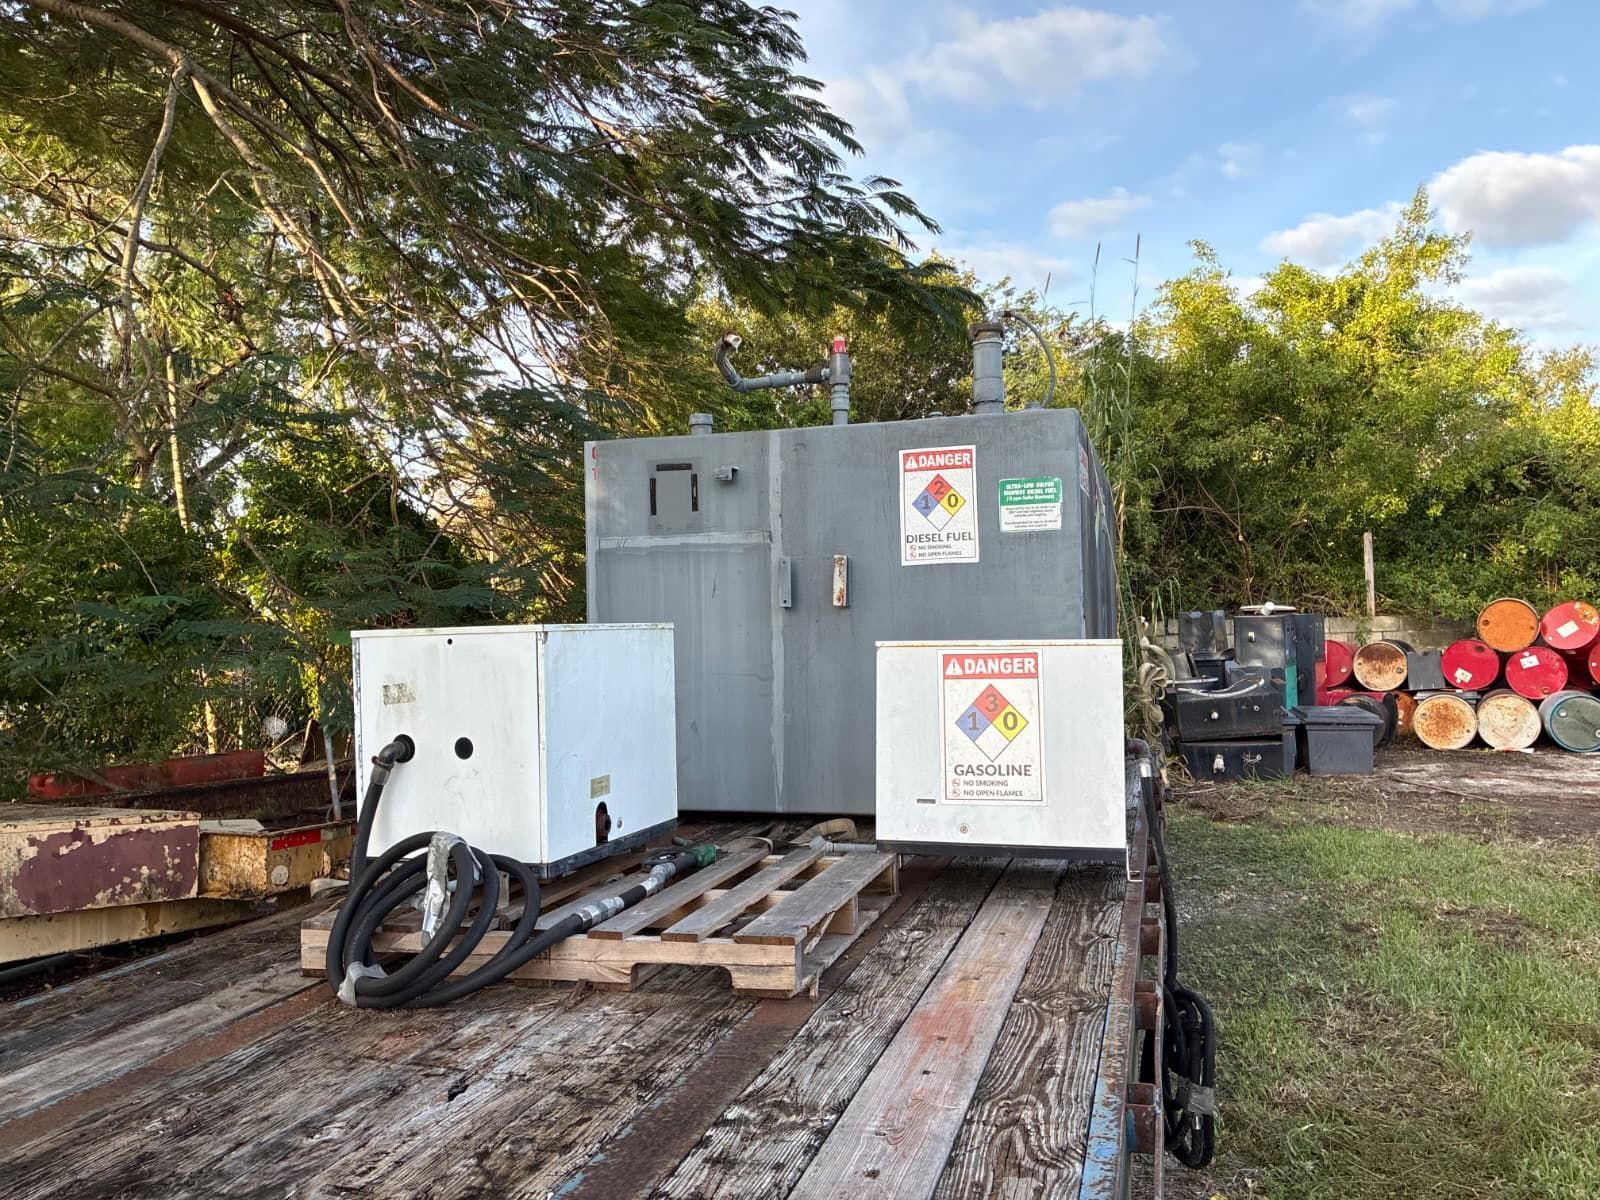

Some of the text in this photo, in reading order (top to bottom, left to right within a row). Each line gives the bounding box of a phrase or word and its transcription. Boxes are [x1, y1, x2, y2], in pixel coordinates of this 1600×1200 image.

[918, 452, 971, 466] DANGER
[933, 481, 945, 495] 2
[920, 493, 959, 509] 1 0
[906, 532, 974, 543] DIESEL FUEL
[964, 657, 1036, 674] DANGER
[984, 693, 999, 713] 3
[968, 711, 1018, 731] 1 0
[954, 764, 1032, 776] GASOLINE
